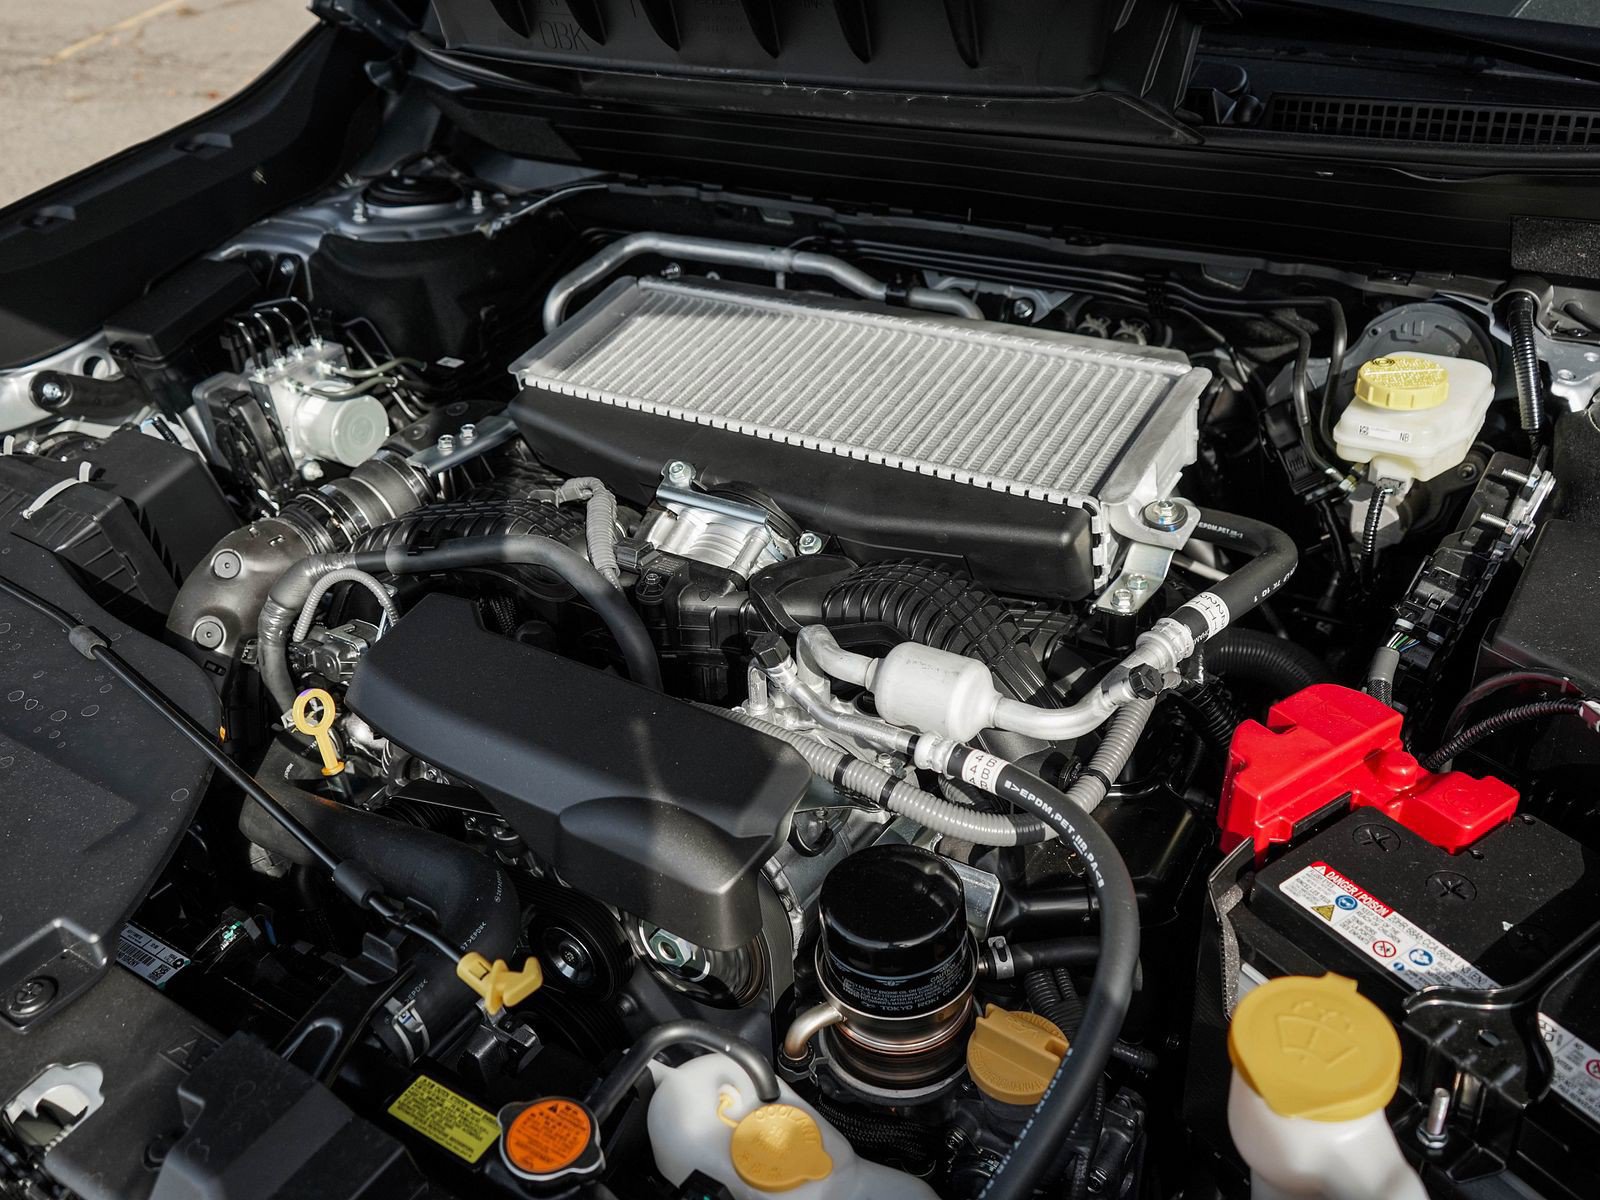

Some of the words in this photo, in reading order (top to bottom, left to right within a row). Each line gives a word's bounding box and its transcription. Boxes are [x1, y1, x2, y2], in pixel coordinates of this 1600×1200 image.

[539, 20, 590, 52] OBK
[1326, 871, 1358, 896] DANGER
[1358, 895, 1389, 918] POISON
